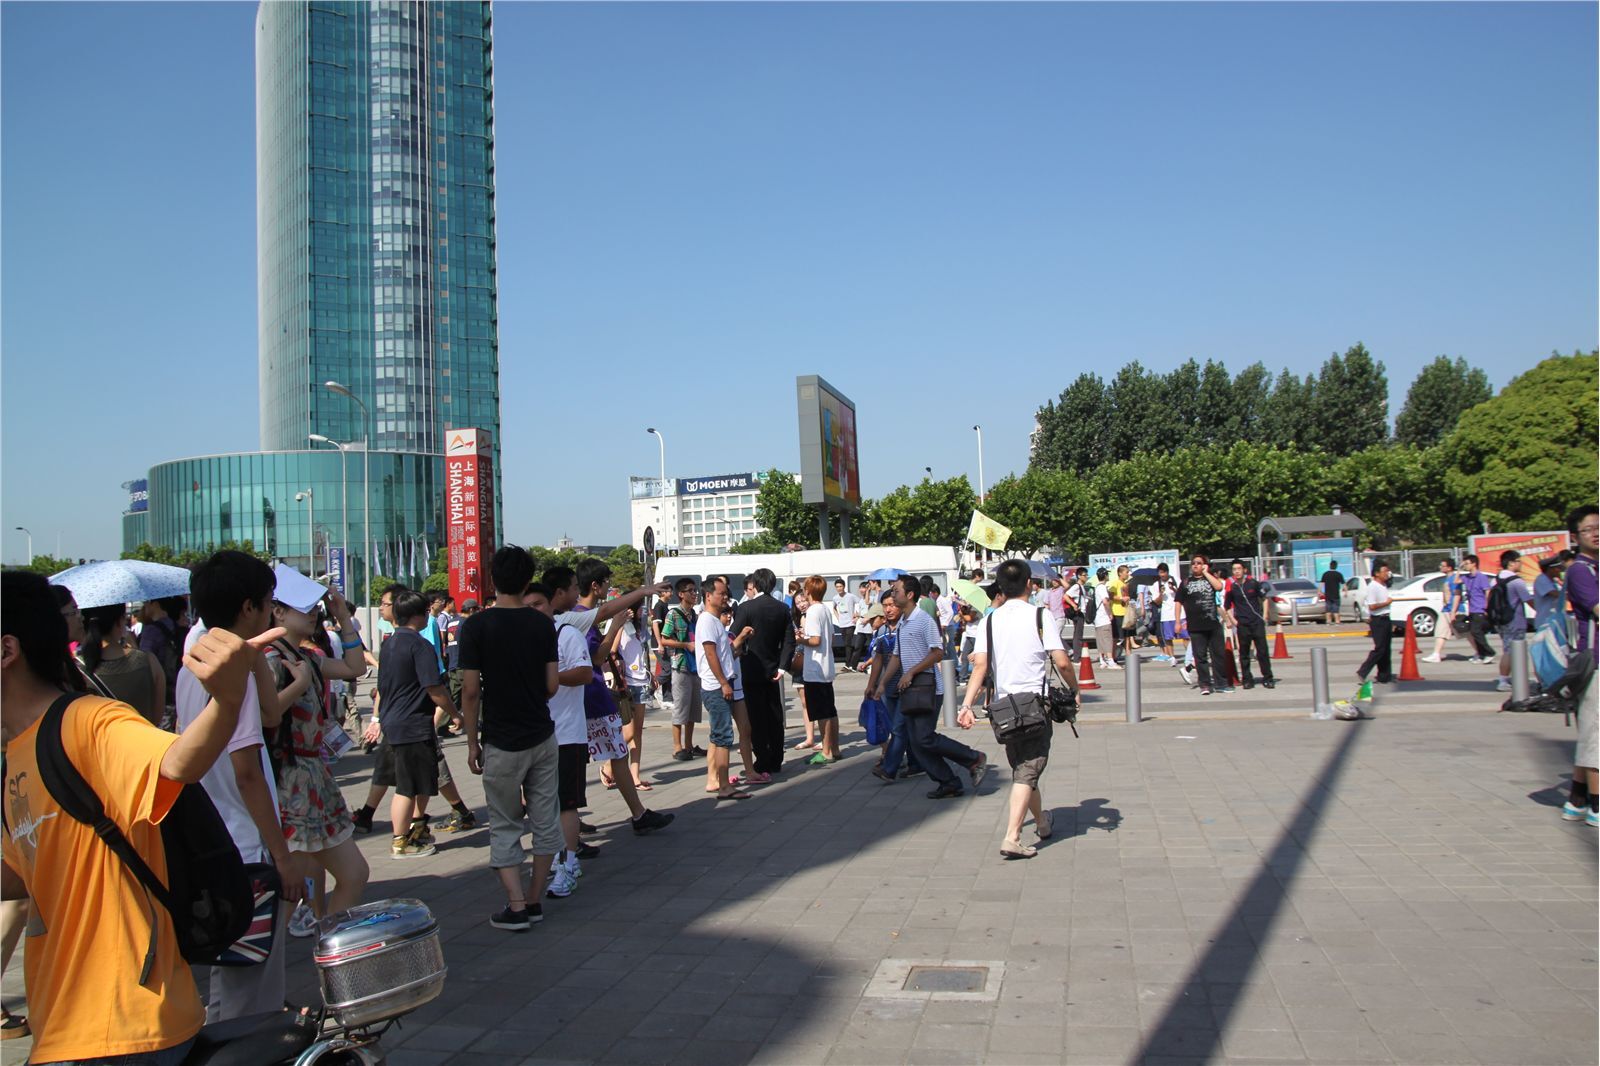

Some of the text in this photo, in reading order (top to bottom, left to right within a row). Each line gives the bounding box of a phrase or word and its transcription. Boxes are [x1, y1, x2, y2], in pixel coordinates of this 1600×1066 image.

[449, 461, 464, 525] SHANGHAI
[699, 479, 729, 489] MOEN
[463, 461, 477, 593] 上海新国际博览中心
